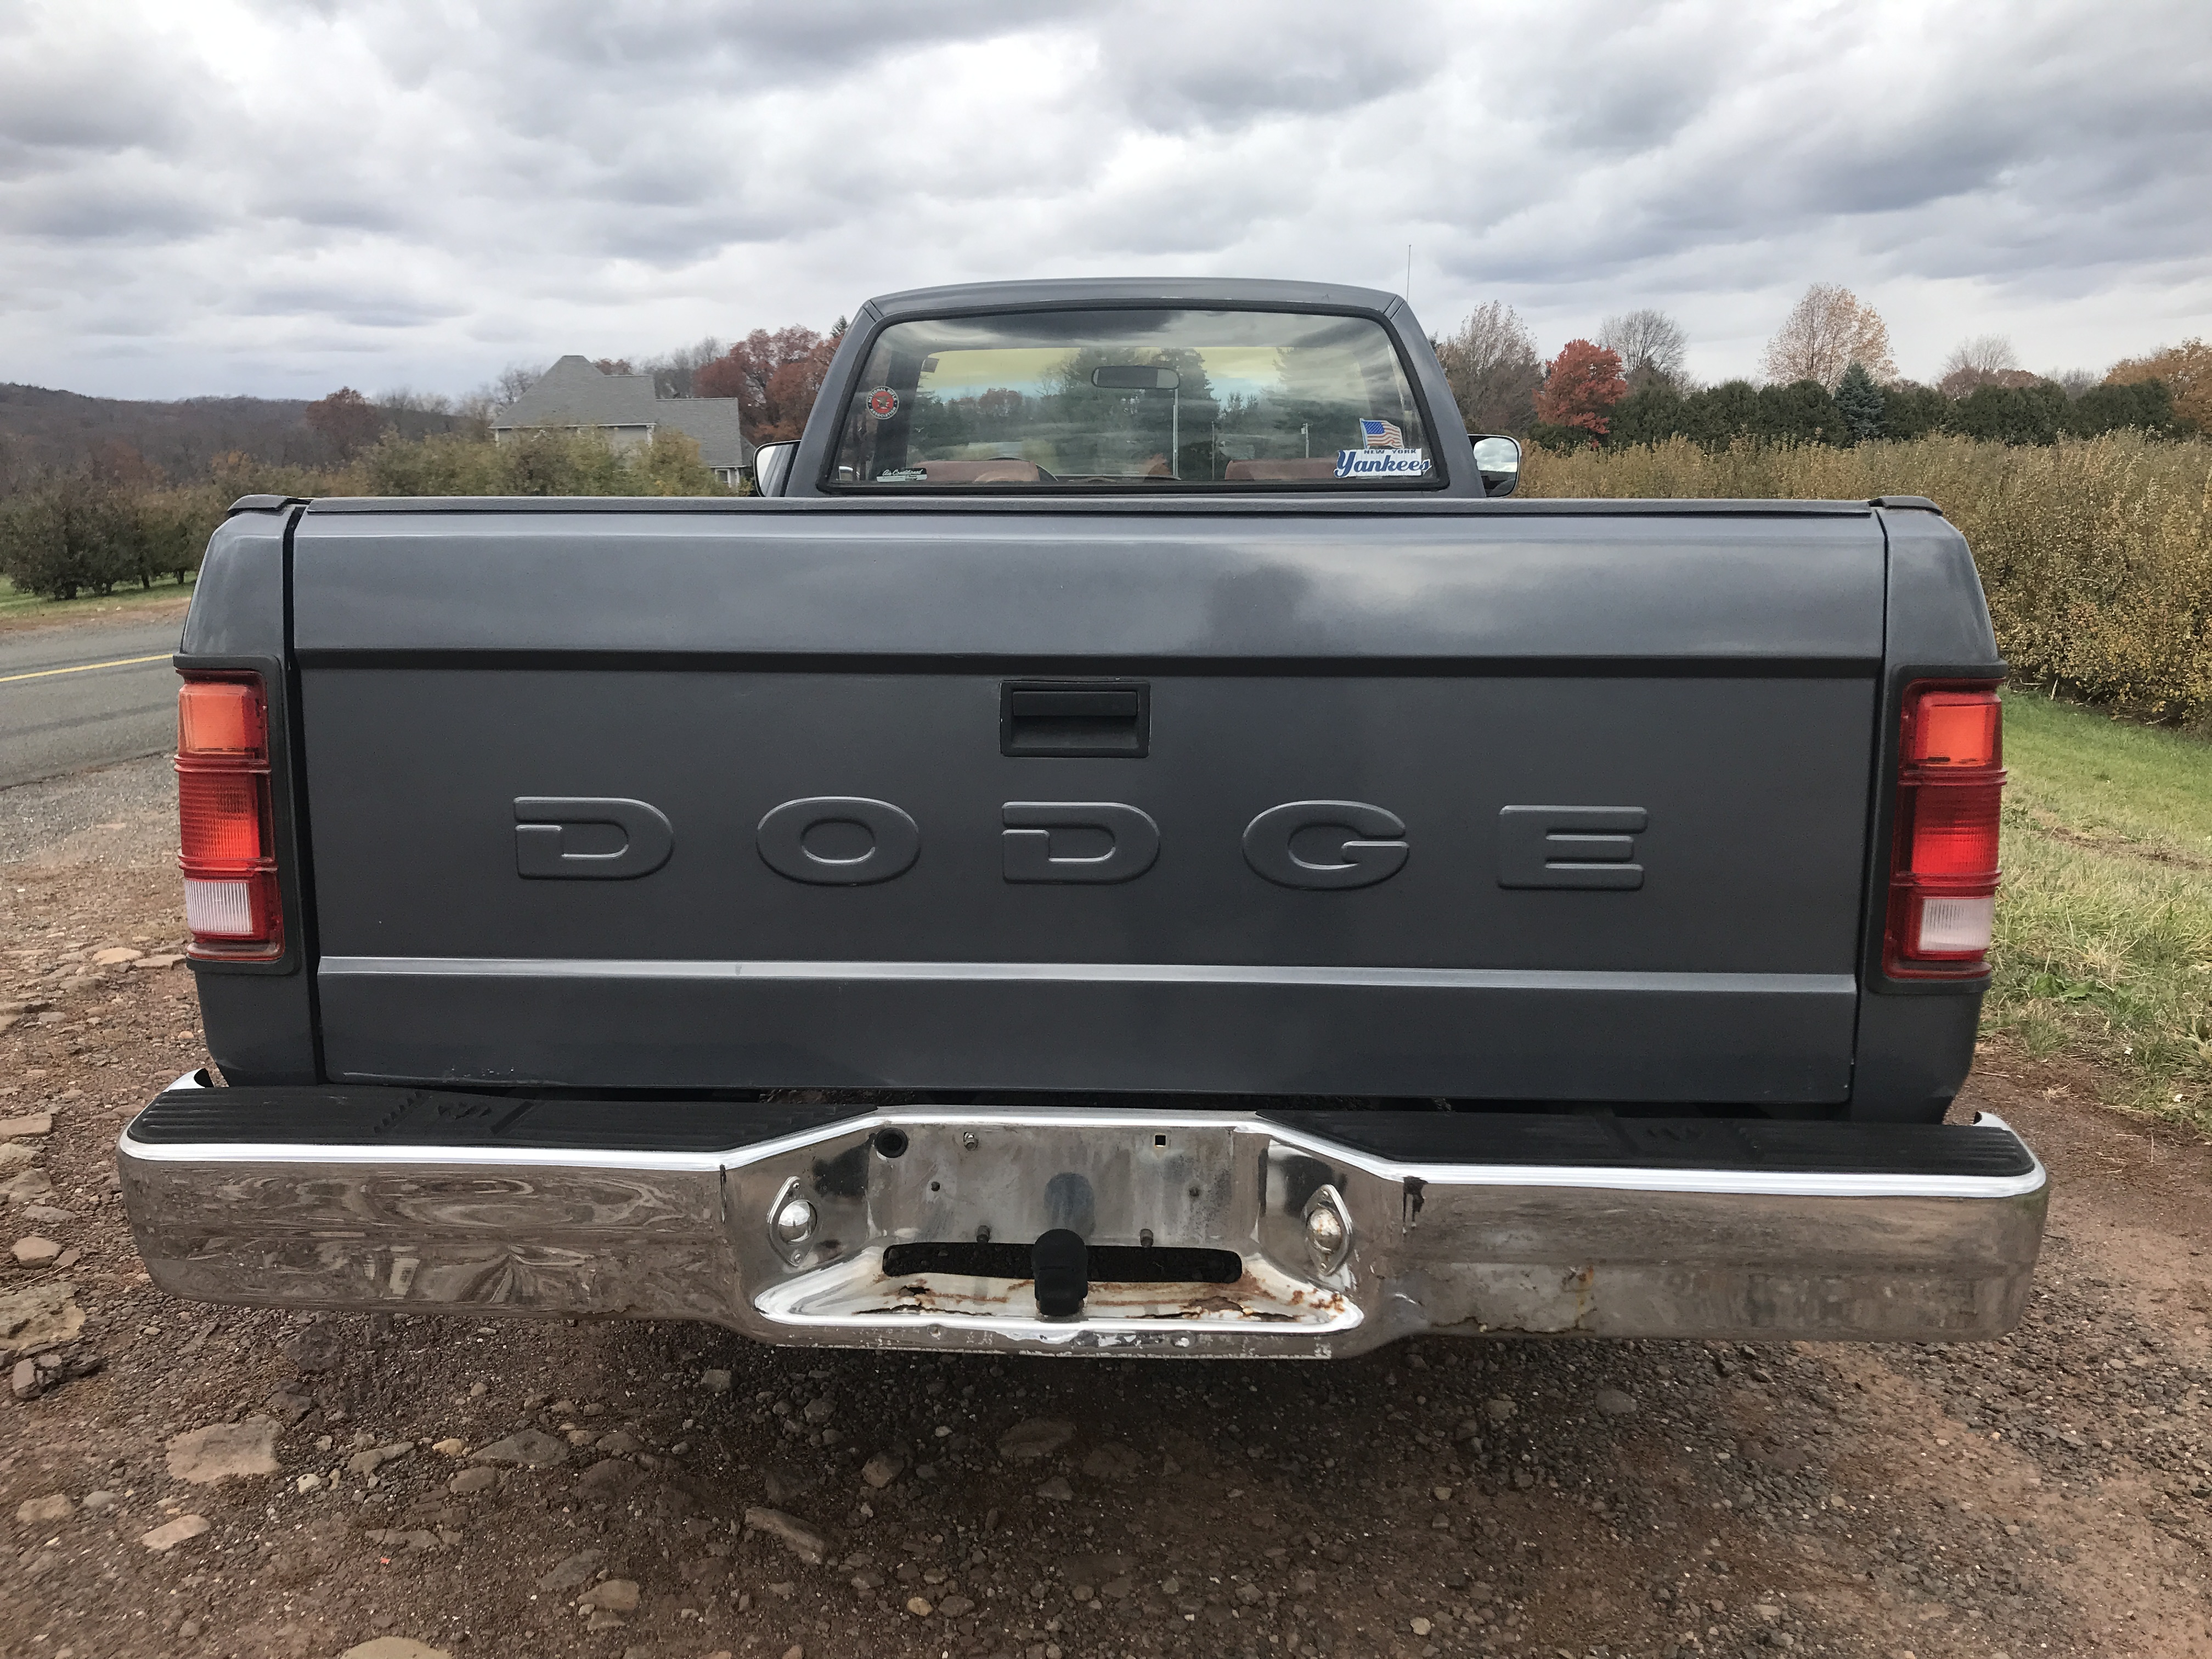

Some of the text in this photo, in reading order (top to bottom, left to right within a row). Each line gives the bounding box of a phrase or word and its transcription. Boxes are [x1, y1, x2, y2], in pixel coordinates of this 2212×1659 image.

[868, 387, 897, 403] NATIONAL RIFLE
[870, 407, 896, 417] ASSOCIATION
[1334, 450, 1430, 477] Yankees
[514, 796, 1647, 890] DODGE
